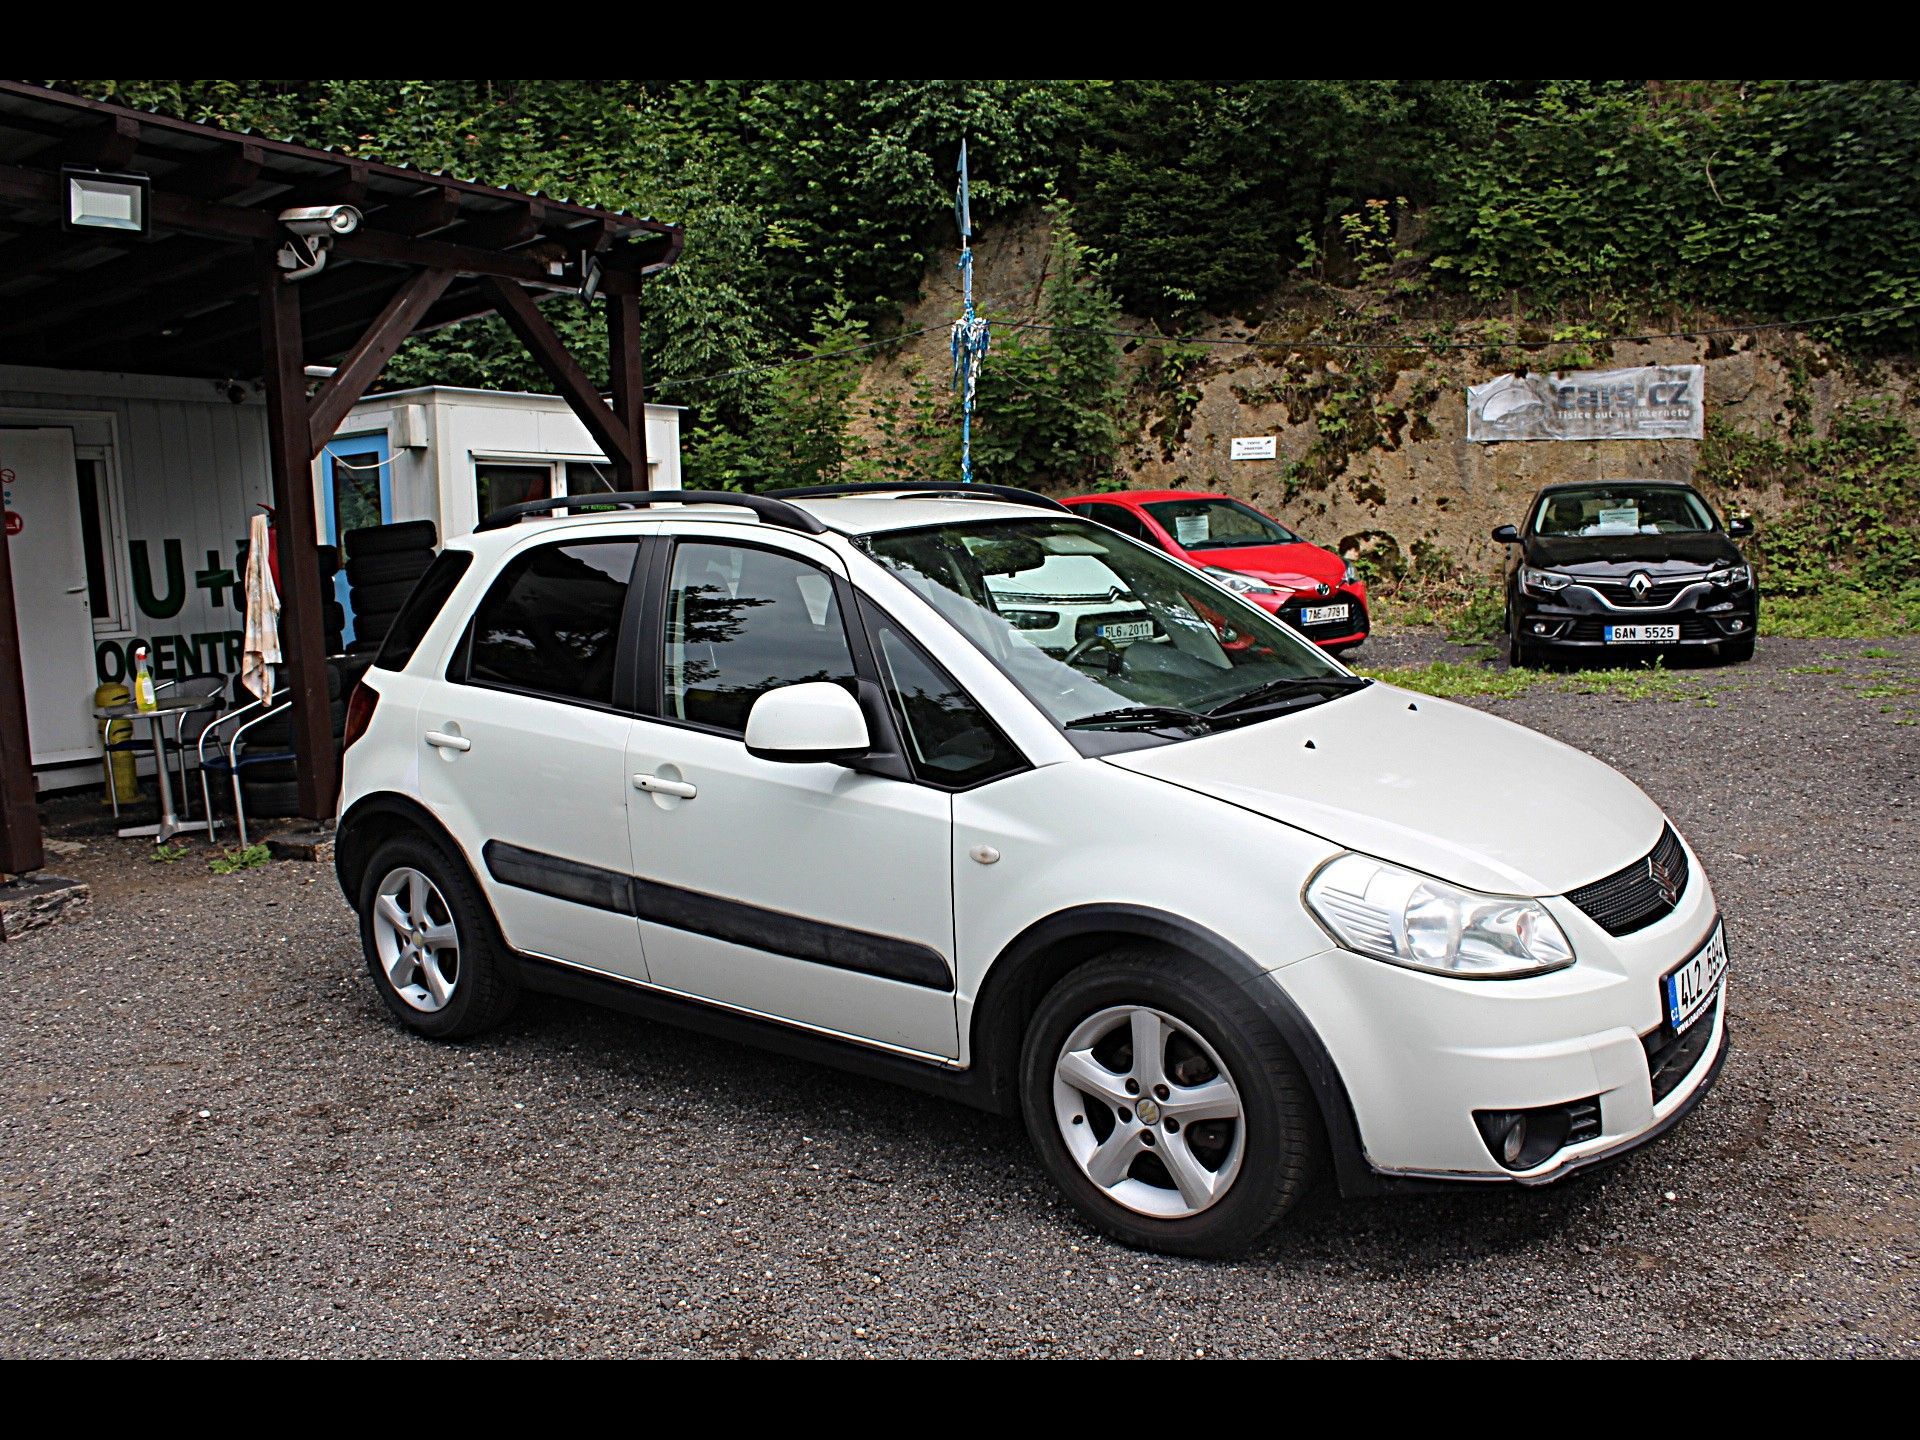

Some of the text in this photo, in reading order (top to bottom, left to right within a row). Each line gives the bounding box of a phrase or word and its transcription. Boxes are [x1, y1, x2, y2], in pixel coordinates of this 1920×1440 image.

[129, 539, 250, 619] U+
[1308, 606, 1345, 620] 7AE 7791
[1105, 622, 1149, 638] 5L6 2011
[1614, 626, 1674, 639] 6AN 5525
[1681, 959, 1703, 1009] 4L2
